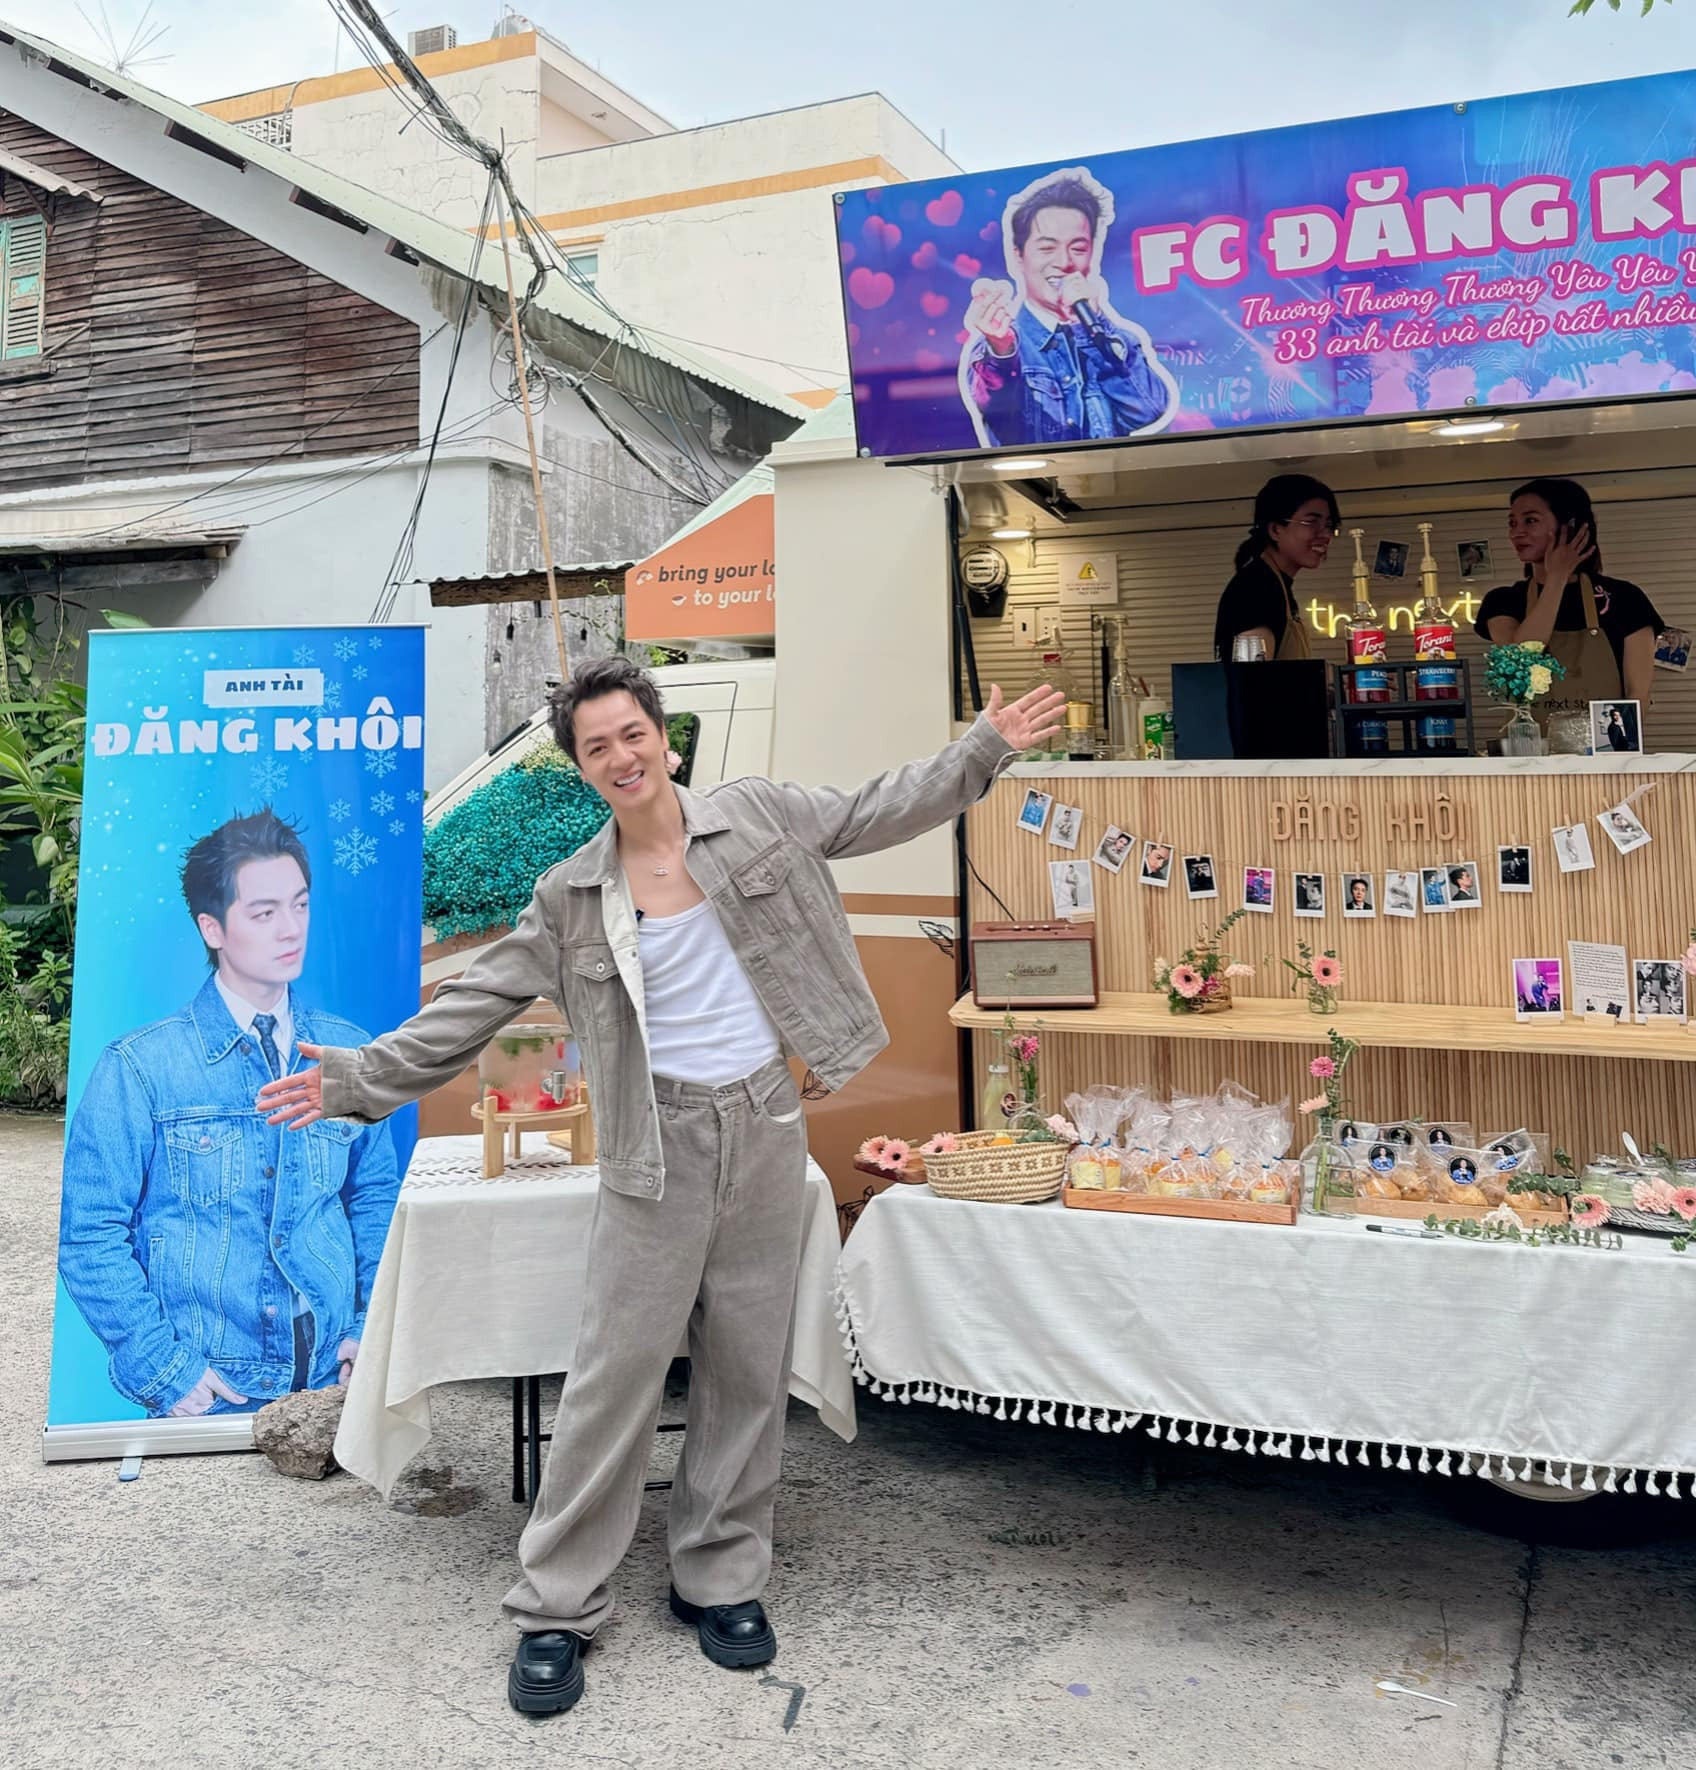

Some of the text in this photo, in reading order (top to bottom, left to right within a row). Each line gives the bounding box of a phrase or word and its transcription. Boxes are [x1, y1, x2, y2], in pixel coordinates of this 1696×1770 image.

[1138, 222, 1242, 288] FC
[1267, 174, 1569, 272] ĐĂNG
[1242, 297, 1334, 326] Thương
[1342, 285, 1437, 315] Thương
[1445, 274, 1543, 304] Thương
[1551, 263, 1609, 297] Yêu
[1615, 256, 1675, 291] Yêu
[1277, 327, 1317, 361] 33
[1326, 321, 1384, 354] anh
[1392, 321, 1434, 349] tài
[1442, 316, 1479, 343] và
[1557, 302, 1606, 332] rất
[658, 565, 708, 585] bring
[714, 564, 757, 584] your
[693, 584, 775, 609] to your l
[1305, 598, 1377, 639] th
[1416, 631, 1454, 654] Torani
[225, 673, 304, 692] ANH TÀI
[91, 696, 422, 757] ĐĂNG KHÔI
[1269, 792, 1468, 842] ĐĂNG KHÔI
